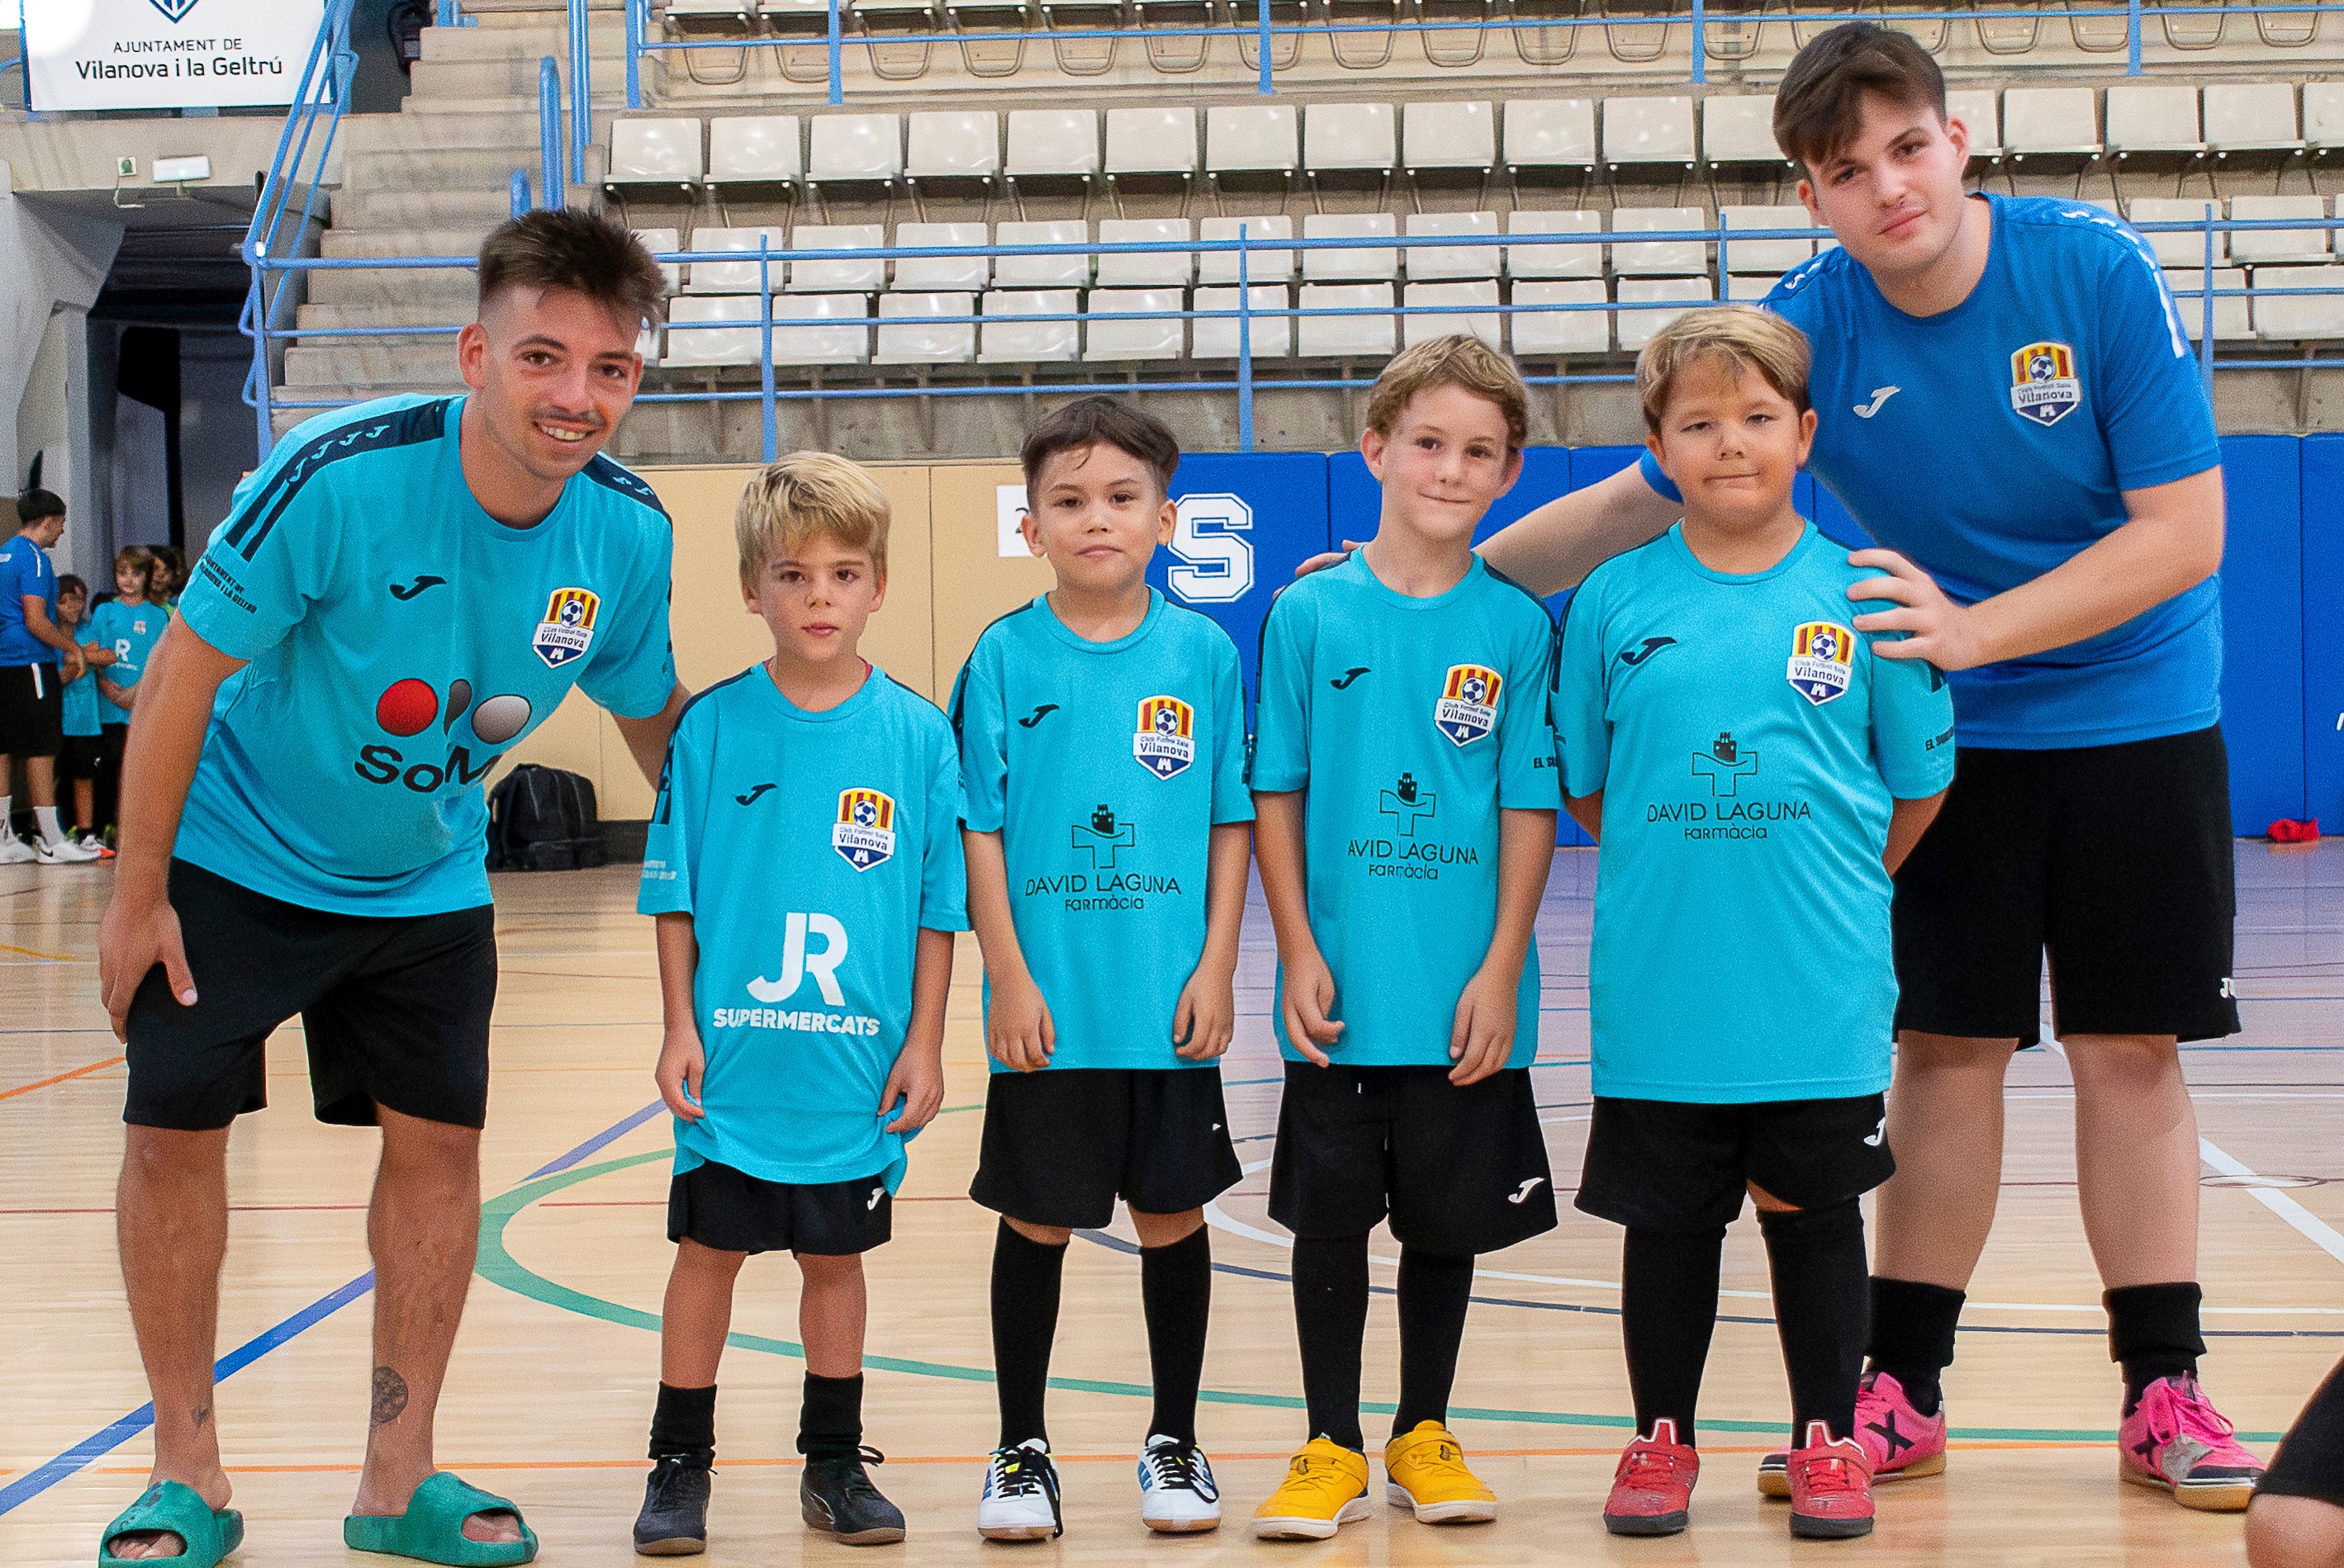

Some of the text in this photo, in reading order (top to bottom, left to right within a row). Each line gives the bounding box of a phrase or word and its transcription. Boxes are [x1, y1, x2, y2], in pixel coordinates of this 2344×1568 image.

[113, 38, 242, 54] AJUNTAMENT DE
[75, 55, 282, 80] Vilanova i la Geltrú
[2018, 391, 2073, 404] Vilanova
[541, 632, 585, 649] Vilanova
[1795, 666, 1844, 685] Vilanova
[1442, 708, 1489, 727] Vilanova
[1140, 742, 1189, 759] Vilanova
[1647, 801, 1811, 822] DAVID LAGUNA
[839, 833, 888, 851] Vilanova
[1398, 841, 1478, 865] LAGUNA
[1025, 873, 1182, 897] DAVID LAGUNA
[746, 912, 848, 1007] JR
[713, 1007, 880, 1036] SUPERMERCATS
